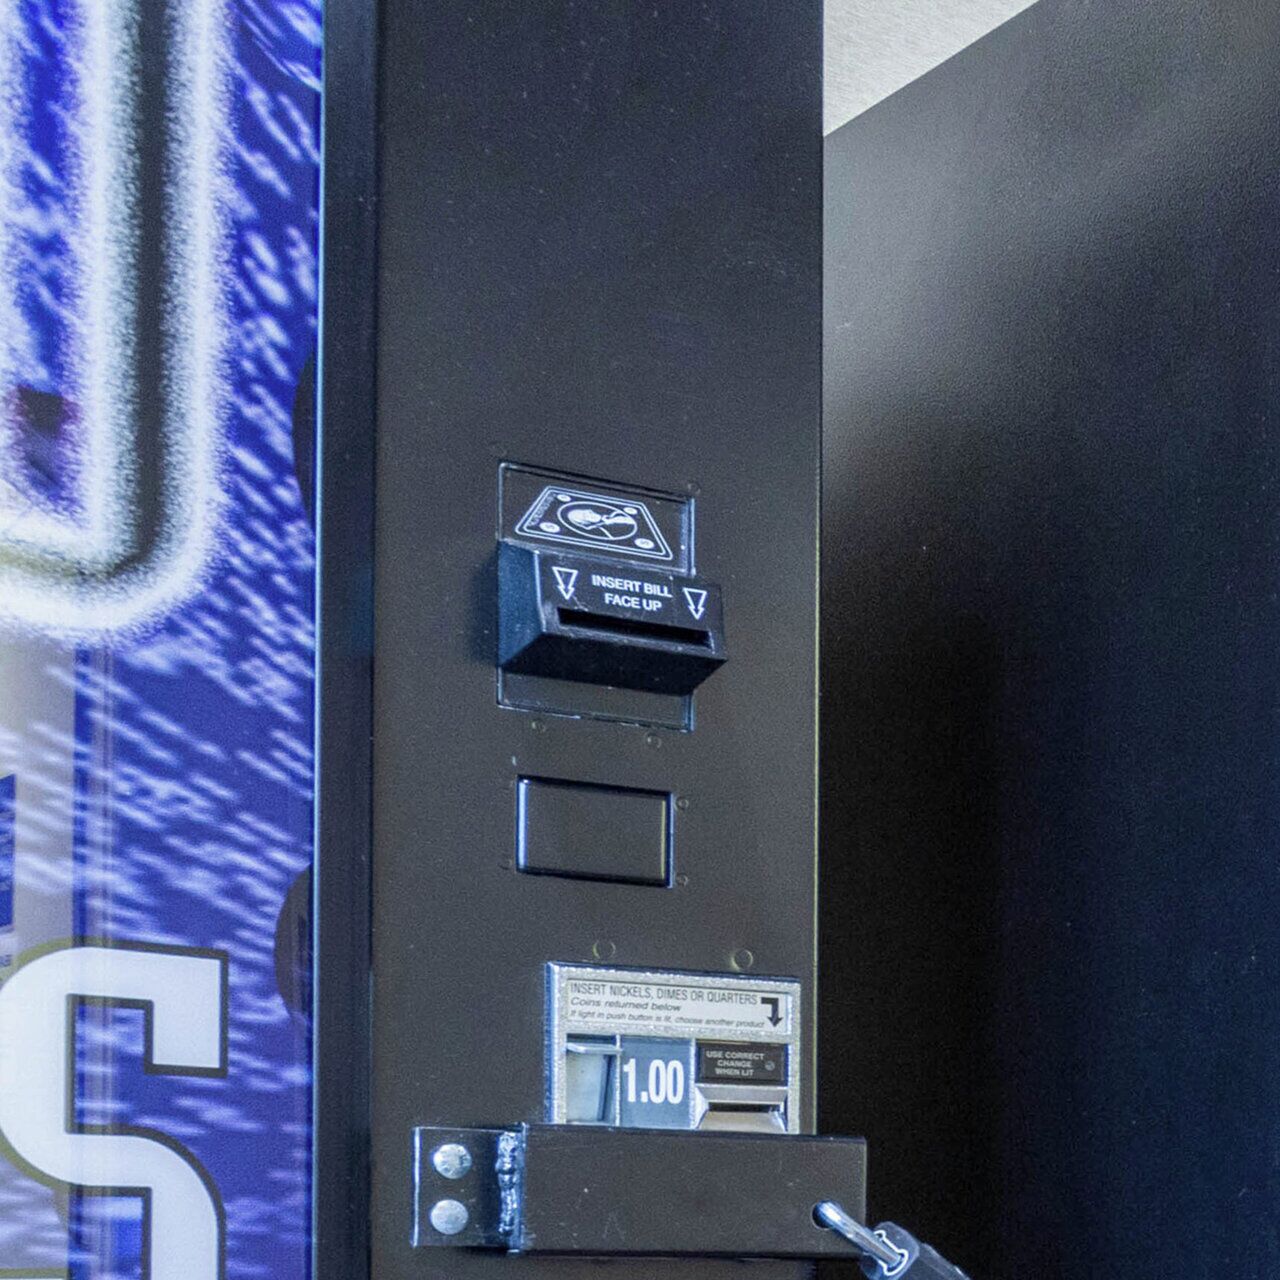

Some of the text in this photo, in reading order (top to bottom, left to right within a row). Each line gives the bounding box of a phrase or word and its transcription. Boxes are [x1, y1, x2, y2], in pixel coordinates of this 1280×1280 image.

[591, 574, 673, 598] INSERT BILL
[604, 592, 662, 612] FACE UP
[570, 983, 758, 1005] INSERT NICKELS, DIMES OR QUARTERS
[570, 997, 682, 1012] Coins returned below
[706, 1050, 765, 1061] USE CORRECT
[717, 1059, 753, 1069] CHANGE
[715, 1067, 754, 1077] WHEN LIT
[623, 1057, 685, 1105] 1.00
